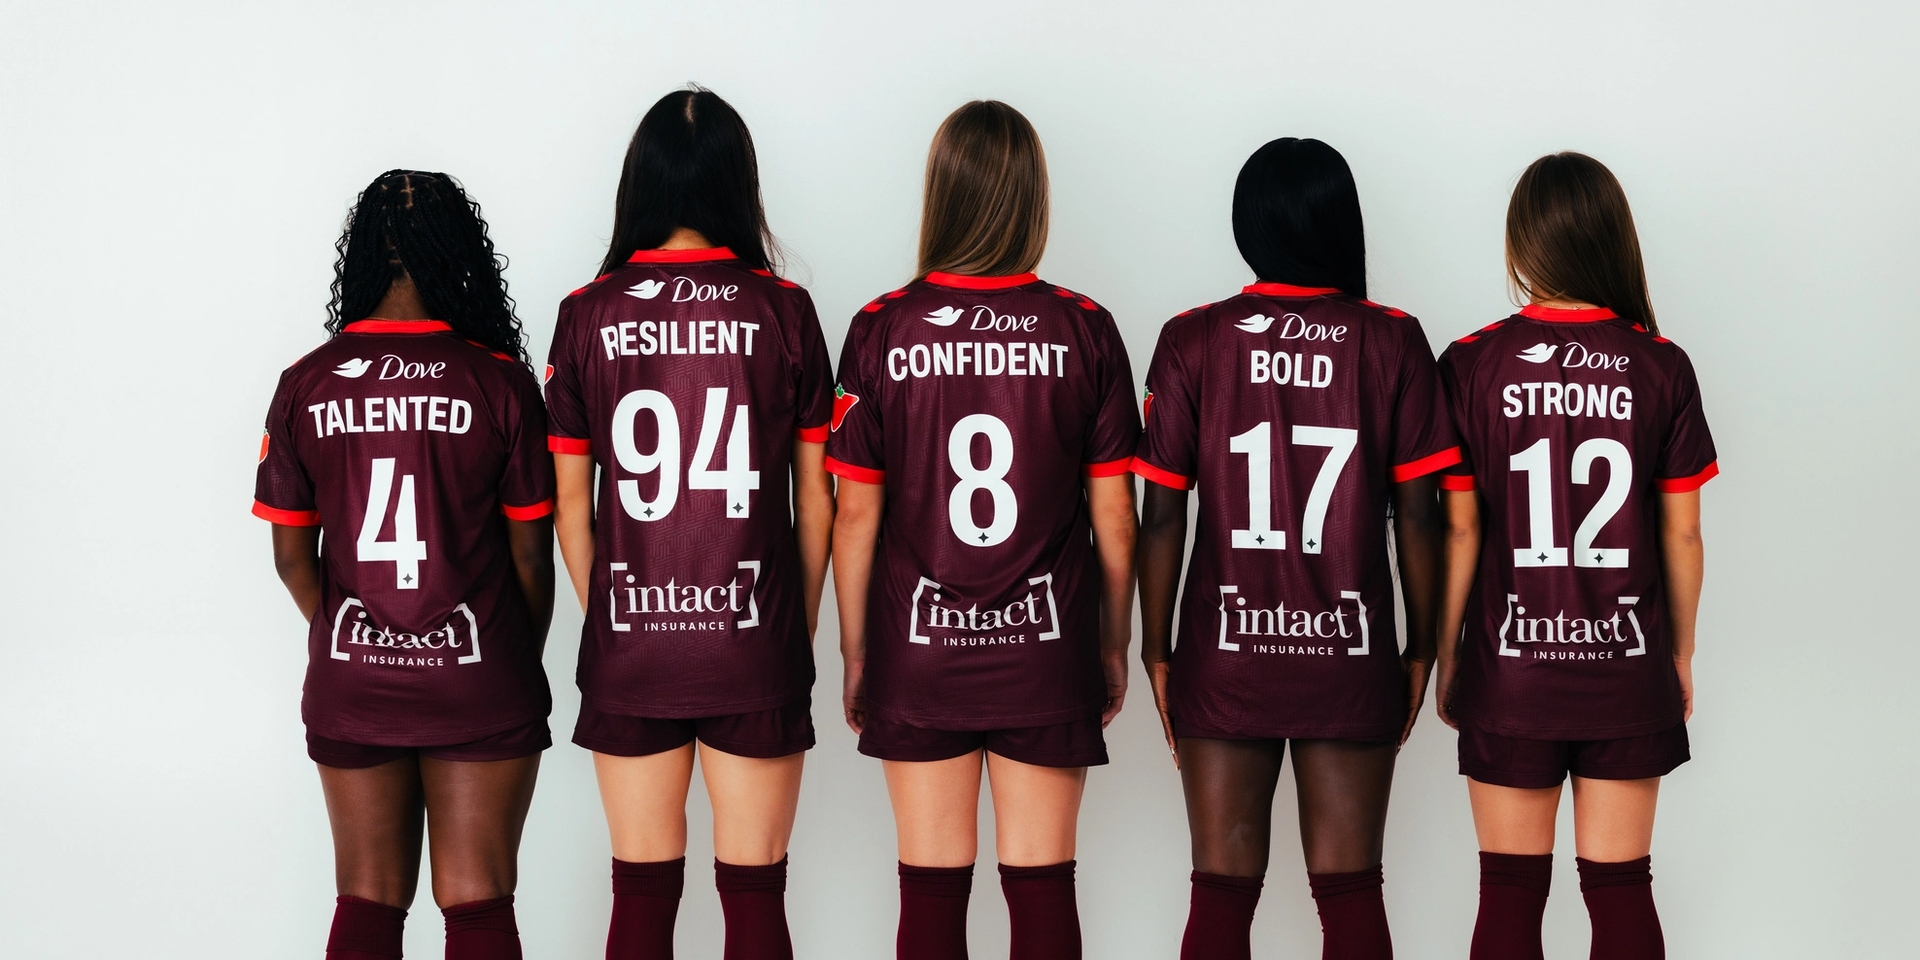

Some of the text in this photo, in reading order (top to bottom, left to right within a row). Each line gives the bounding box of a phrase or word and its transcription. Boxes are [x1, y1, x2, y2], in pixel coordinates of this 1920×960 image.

[671, 275, 739, 303] Dove
[969, 304, 1038, 333] Dove
[1280, 313, 1347, 343] Dove
[600, 321, 760, 361] RESILIENT
[1562, 342, 1629, 373] Dove
[378, 354, 448, 381] Dove
[887, 342, 1069, 382] CONFIDENT
[1250, 350, 1334, 389] BOLD
[307, 395, 473, 439] TALENTED
[1502, 382, 1633, 421] STRONG
[611, 387, 761, 522] 94
[948, 414, 1018, 548] 8
[1229, 421, 1359, 555] 17
[1509, 437, 1633, 569] 12
[356, 457, 428, 590] 4
[644, 622, 725, 632] INSURANCE
[943, 634, 1026, 647] INSURANCE
[362, 654, 444, 667] INSURANCE
[1252, 644, 1334, 656] INSURANCE
[1533, 650, 1614, 660] INSURANCE
